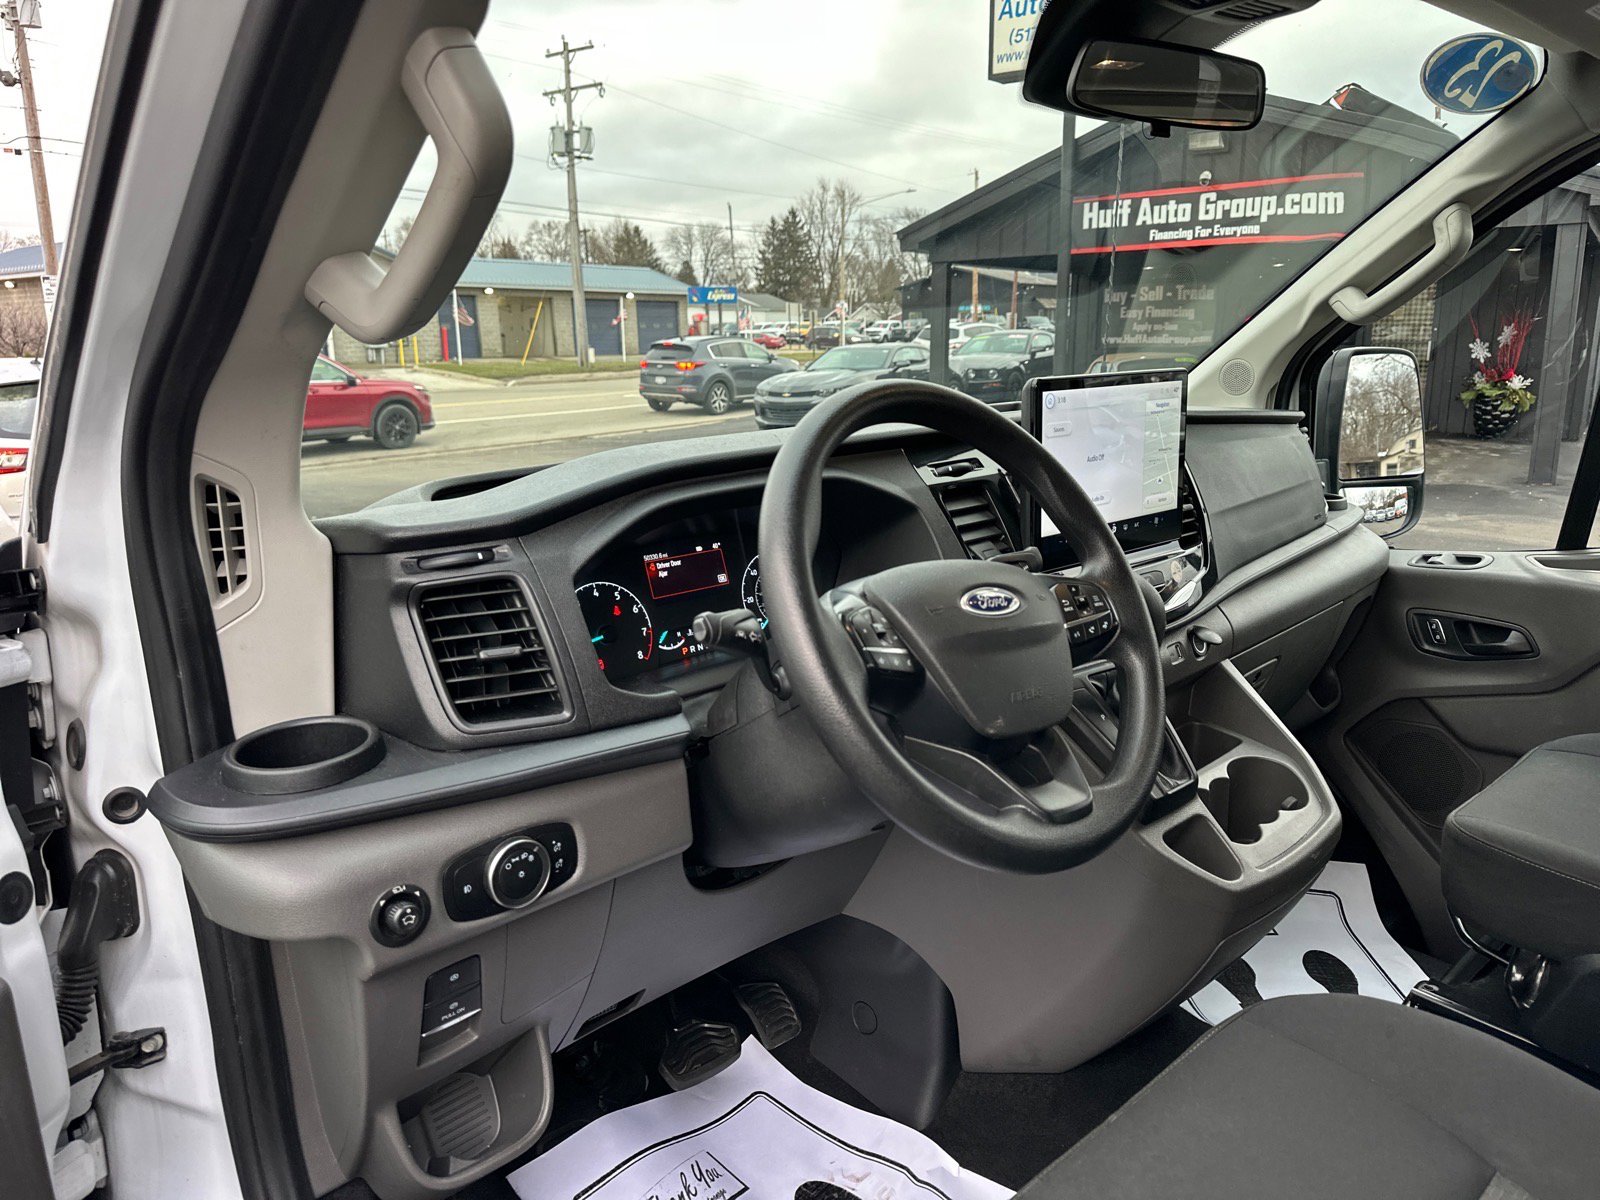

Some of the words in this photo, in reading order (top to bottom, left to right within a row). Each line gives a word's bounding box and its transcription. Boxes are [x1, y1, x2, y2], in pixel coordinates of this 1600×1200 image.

[1082, 200, 1131, 230] Huff
[1135, 197, 1191, 227] Auto
[1198, 192, 1345, 222] Group.com
[1149, 228, 1193, 241] Financing
[1194, 226, 1212, 239] For
[1214, 224, 1260, 238] Everyone
[1104, 288, 1128, 305] Buy
[1140, 285, 1163, 301] Sell
[1176, 284, 1215, 300] Trade
[1120, 306, 1143, 320] Easy
[1145, 305, 1195, 320] Financing
[1086, 455, 1099, 463] Audio
[656, 562, 670, 570] Driver
[593, 588, 599, 597] 4
[614, 591, 620, 601] 5
[747, 596, 754, 604] 20
[977, 593, 1008, 609] Ford
[632, 604, 639, 613] 6
[641, 627, 647, 636] 7
[682, 647, 688, 655] P
[690, 645, 696, 653] R
[697, 643, 704, 651] N
[637, 650, 643, 659] 8
[691, 1160, 722, 1188] You
